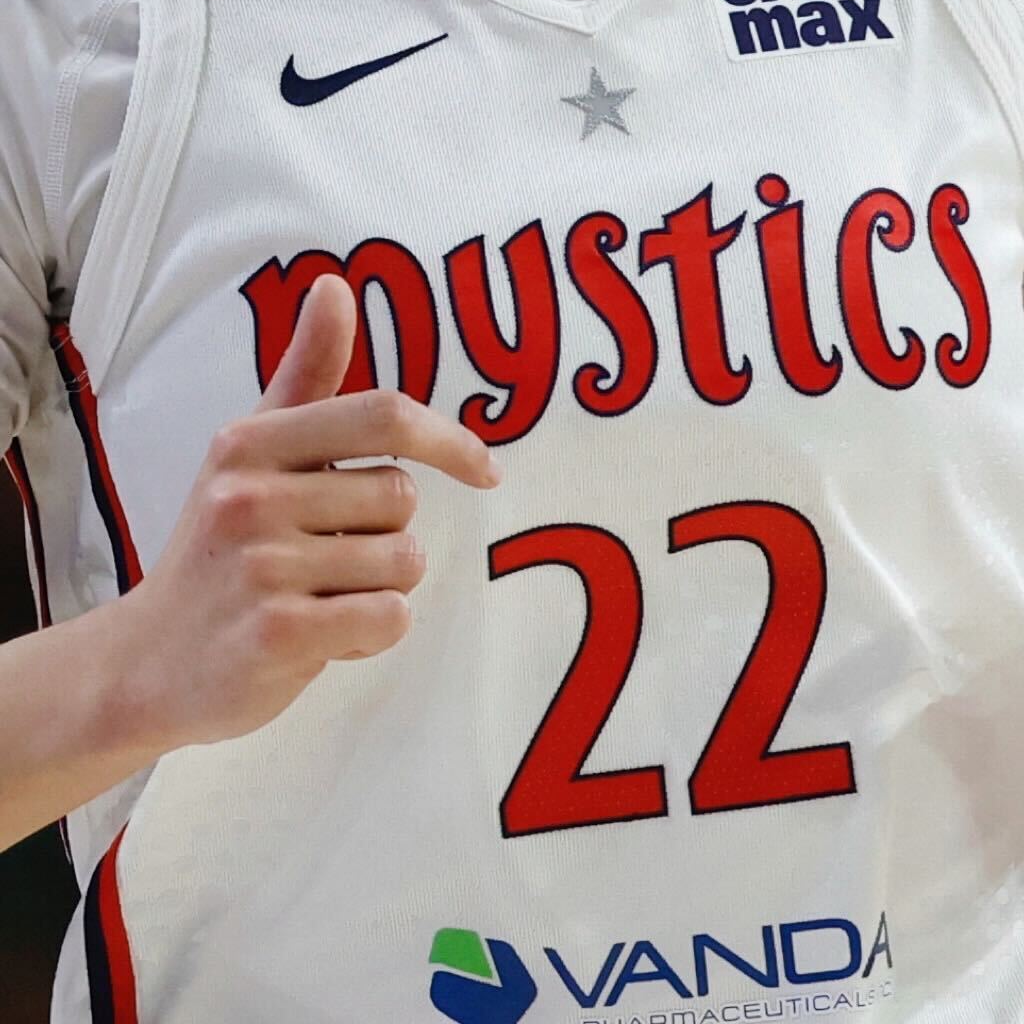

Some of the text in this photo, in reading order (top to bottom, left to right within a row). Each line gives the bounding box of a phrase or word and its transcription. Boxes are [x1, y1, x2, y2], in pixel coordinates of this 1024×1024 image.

[239, 173, 992, 446] mystics
[487, 500, 857, 838] 22
[543, 911, 893, 1008] VANDA
